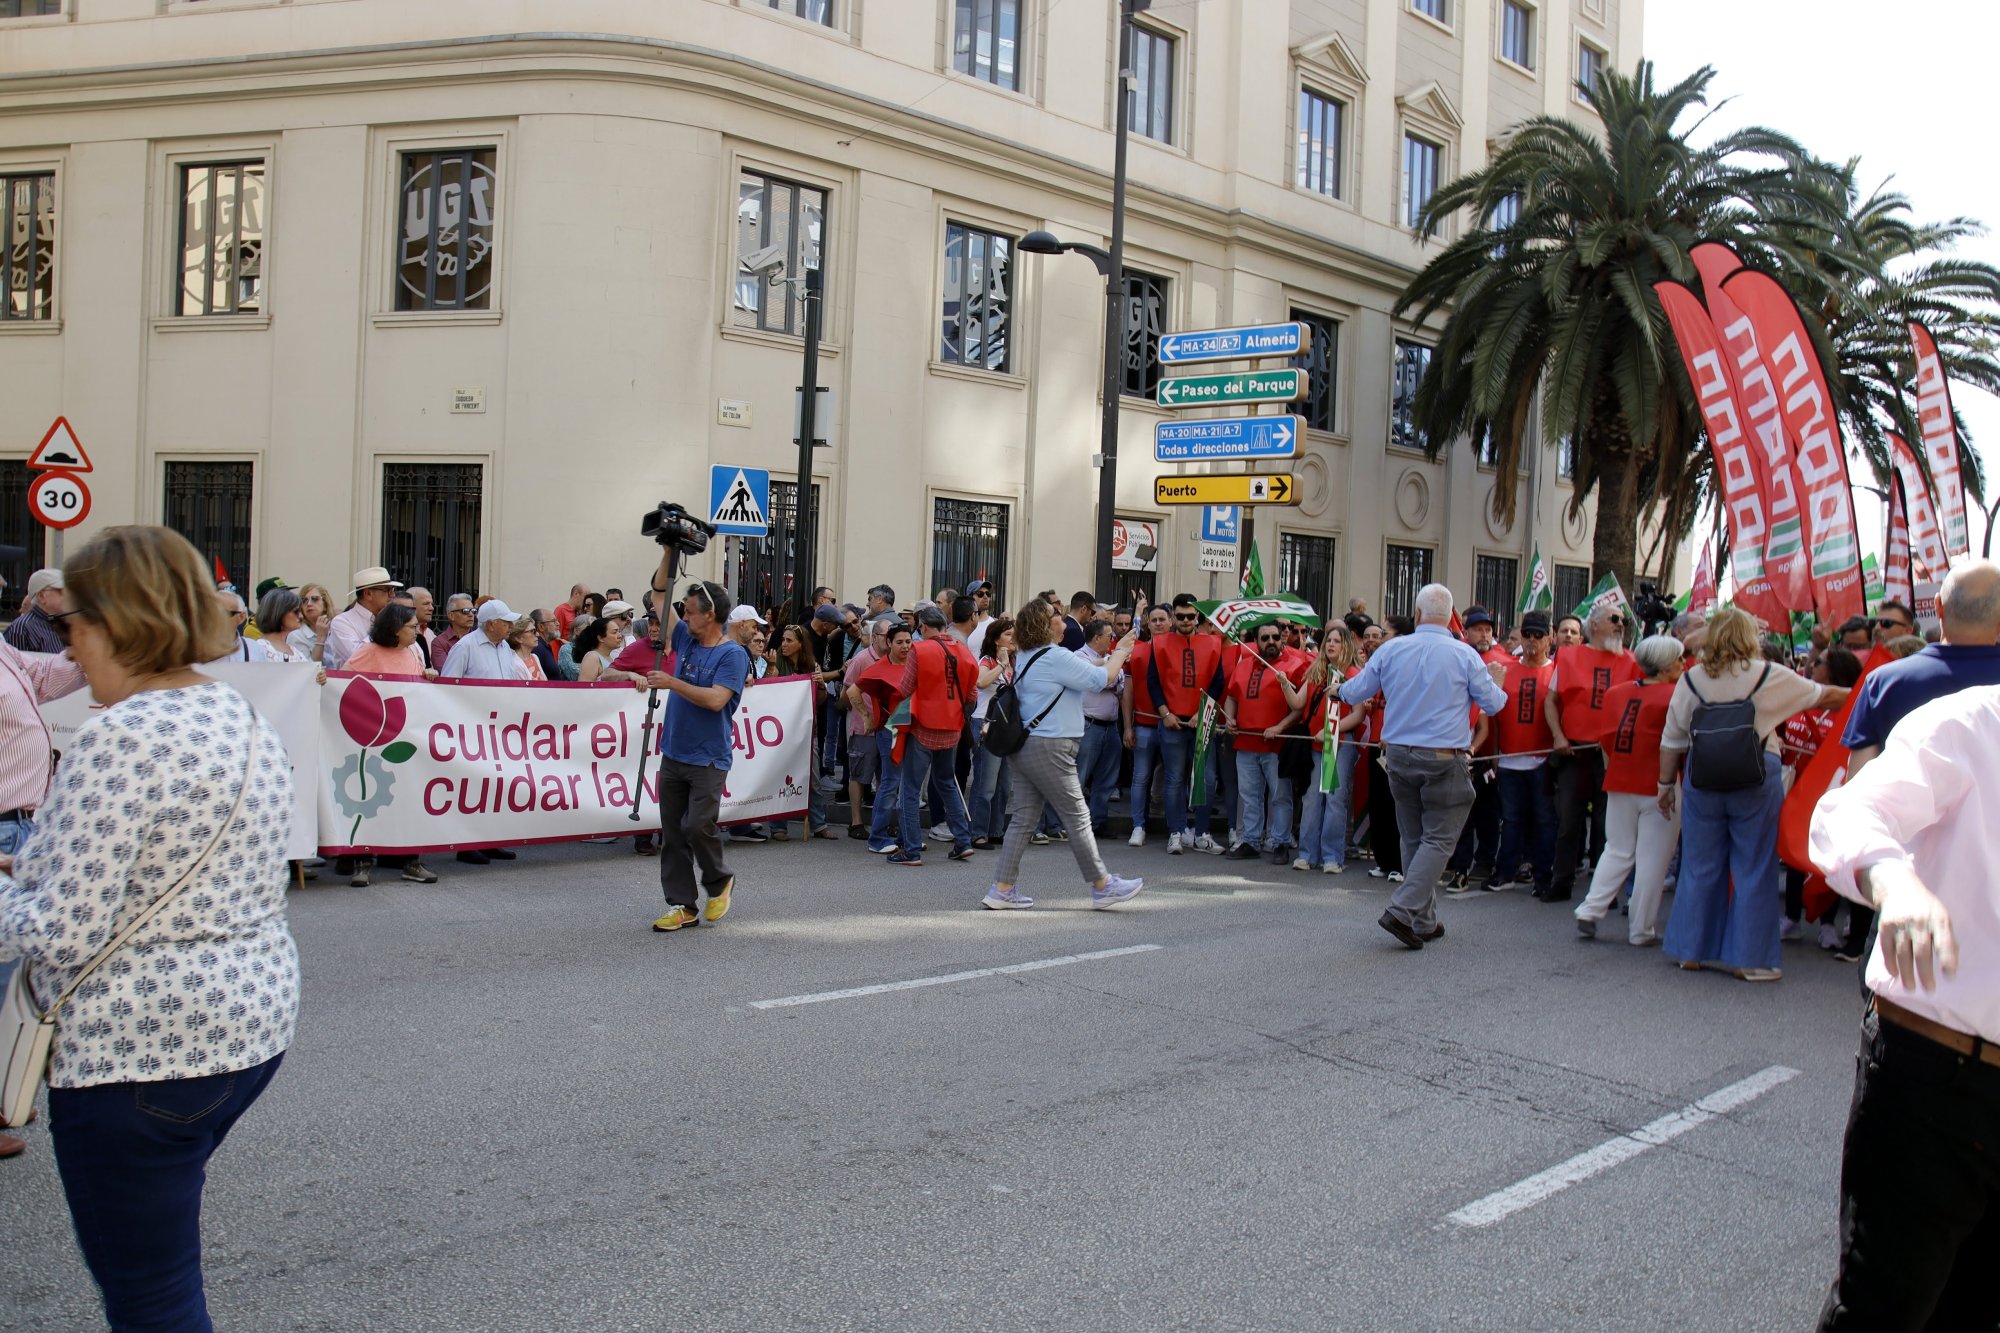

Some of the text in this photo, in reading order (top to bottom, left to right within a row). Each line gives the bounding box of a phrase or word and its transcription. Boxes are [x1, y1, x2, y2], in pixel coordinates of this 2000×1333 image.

[406, 176, 492, 242] UGT
[1183, 340, 1216, 352] MA-24
[1221, 338, 1239, 349] A-7
[1182, 380, 1295, 397] Paseo del Parque
[1161, 426, 1240, 439] MA-20 MA-21 A-7
[1159, 442, 1250, 455] Todas direcciones
[1159, 484, 1197, 496] Puerto
[43, 489, 77, 509] 30
[1210, 506, 1231, 535] P
[1129, 532, 1150, 540] Servicios
[1217, 528, 1235, 537] MOTOS
[1202, 547, 1235, 557] Laborables
[1202, 558, 1209, 567] de
[1220, 560, 1227, 568] 20
[1216, 601, 1281, 627] CCOO
[428, 711, 578, 762] cuidar
[590, 711, 628, 759] el
[423, 763, 582, 816] cuidar
[591, 761, 636, 808] la
